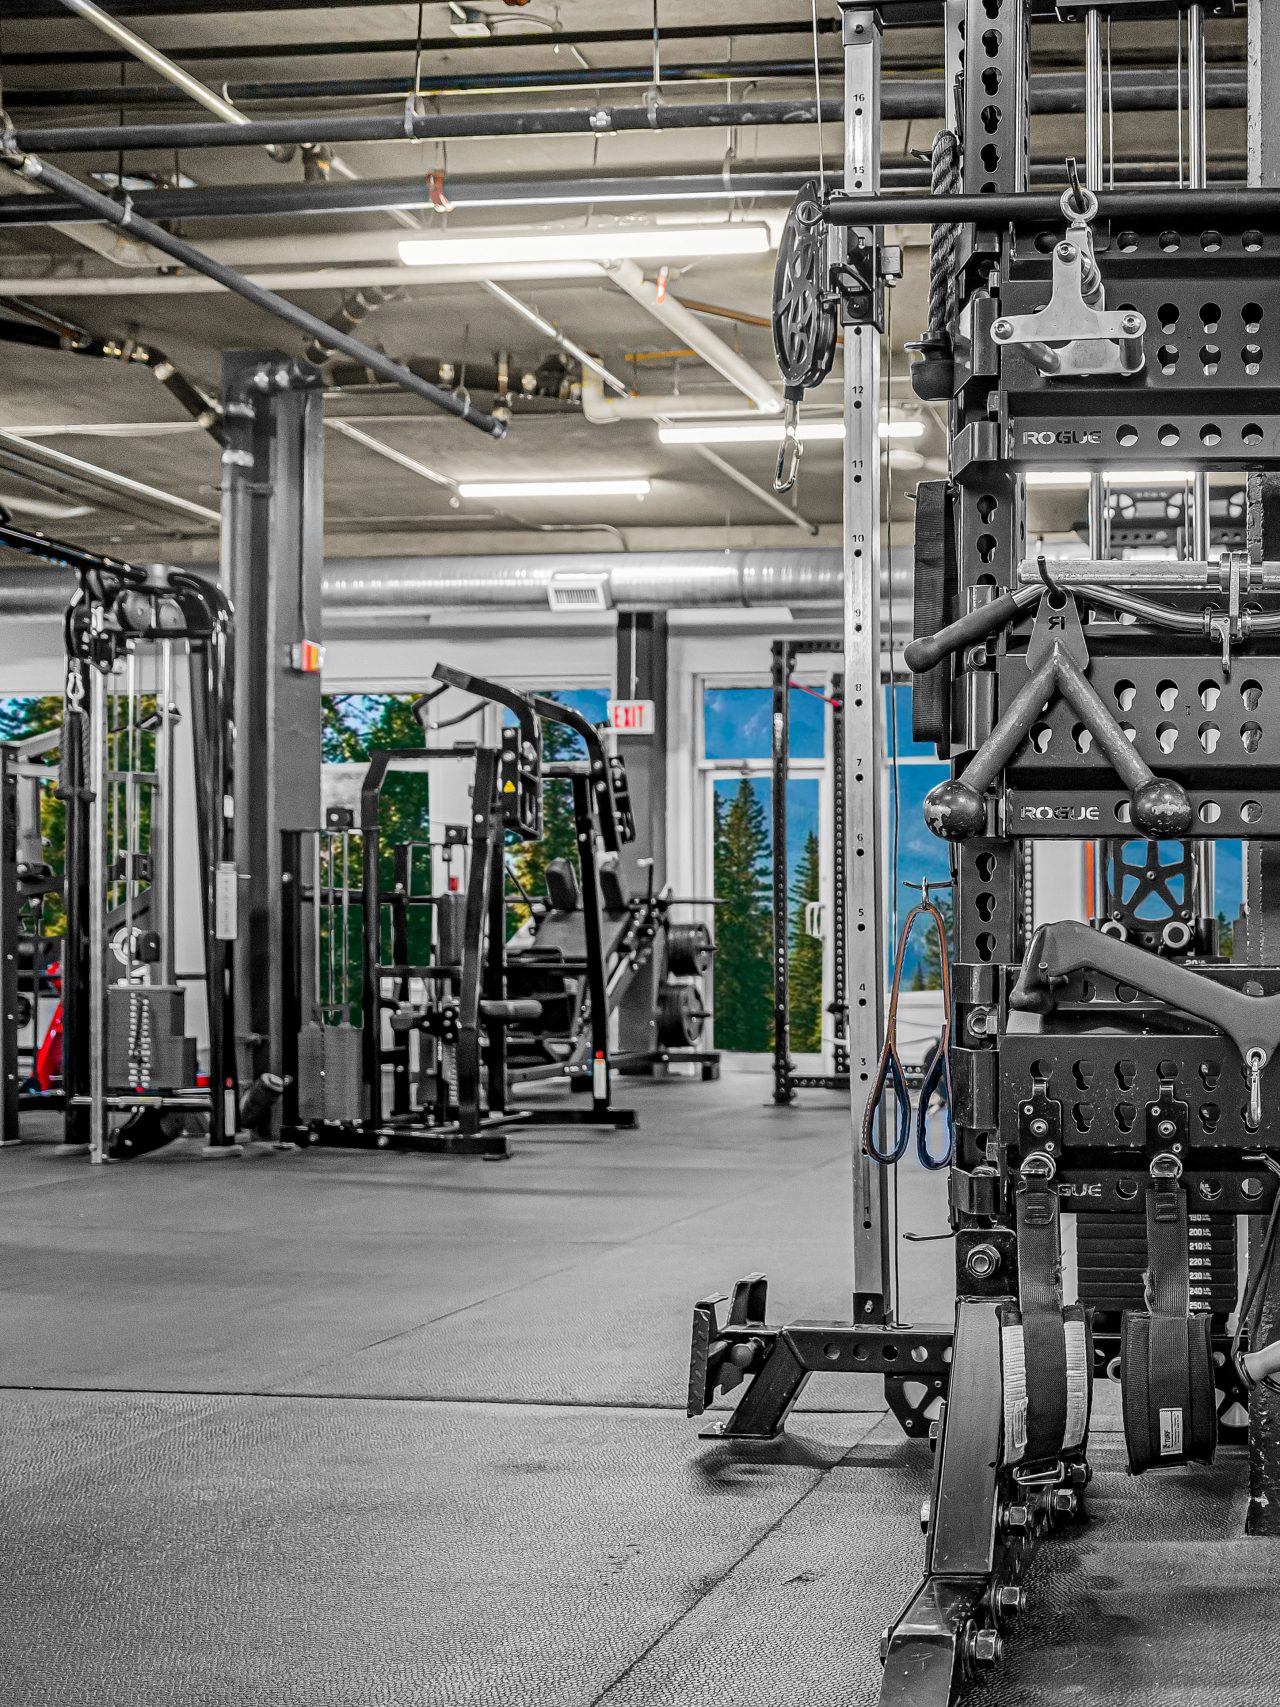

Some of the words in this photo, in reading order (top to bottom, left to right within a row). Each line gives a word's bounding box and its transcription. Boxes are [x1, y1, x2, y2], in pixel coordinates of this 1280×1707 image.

[852, 93, 865, 102] 16
[852, 166, 865, 174] 15
[852, 385, 864, 395] 12
[1022, 431, 1101, 444] ROGUE
[852, 460, 864, 469] 11
[852, 534, 865, 543] 10
[854, 608, 862, 618] 9
[855, 683, 862, 692] 8
[613, 704, 645, 728] EXIT
[856, 758, 862, 767] 7
[1020, 806, 1100, 821] ROGUE
[857, 833, 864, 841] 6
[858, 908, 864, 917] 5
[859, 983, 866, 992] 4
[860, 1057, 867, 1066] 3
[1057, 1183, 1102, 1197] GUE
[1188, 1228, 1203, 1237] 200
[1189, 1242, 1203, 1251] 210
[1189, 1257, 1203, 1266] 220
[1189, 1272, 1203, 1280] 230
[1189, 1287, 1203, 1296] 240
